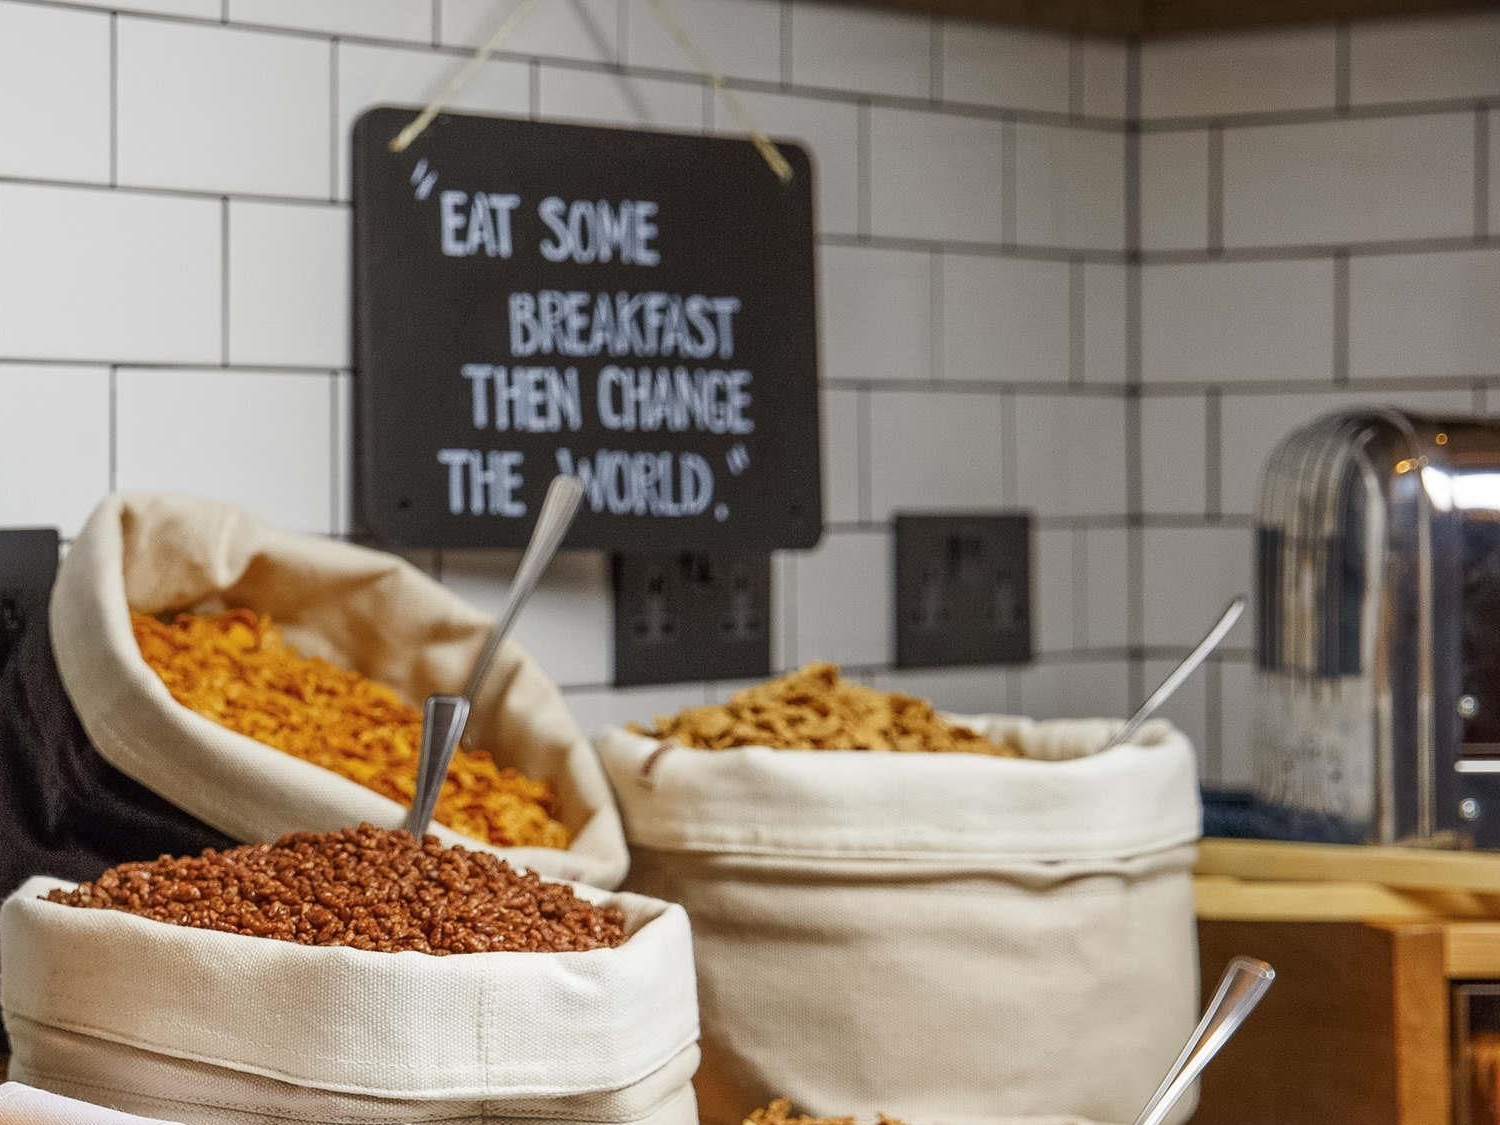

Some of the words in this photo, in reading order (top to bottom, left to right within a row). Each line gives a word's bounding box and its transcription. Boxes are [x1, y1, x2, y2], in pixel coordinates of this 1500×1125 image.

[537, 195, 661, 267] SOME
[508, 289, 741, 359] BREAKFAST
[461, 362, 583, 433] THEN
[596, 364, 755, 435] CHANGE
[436, 447, 528, 518] THE
